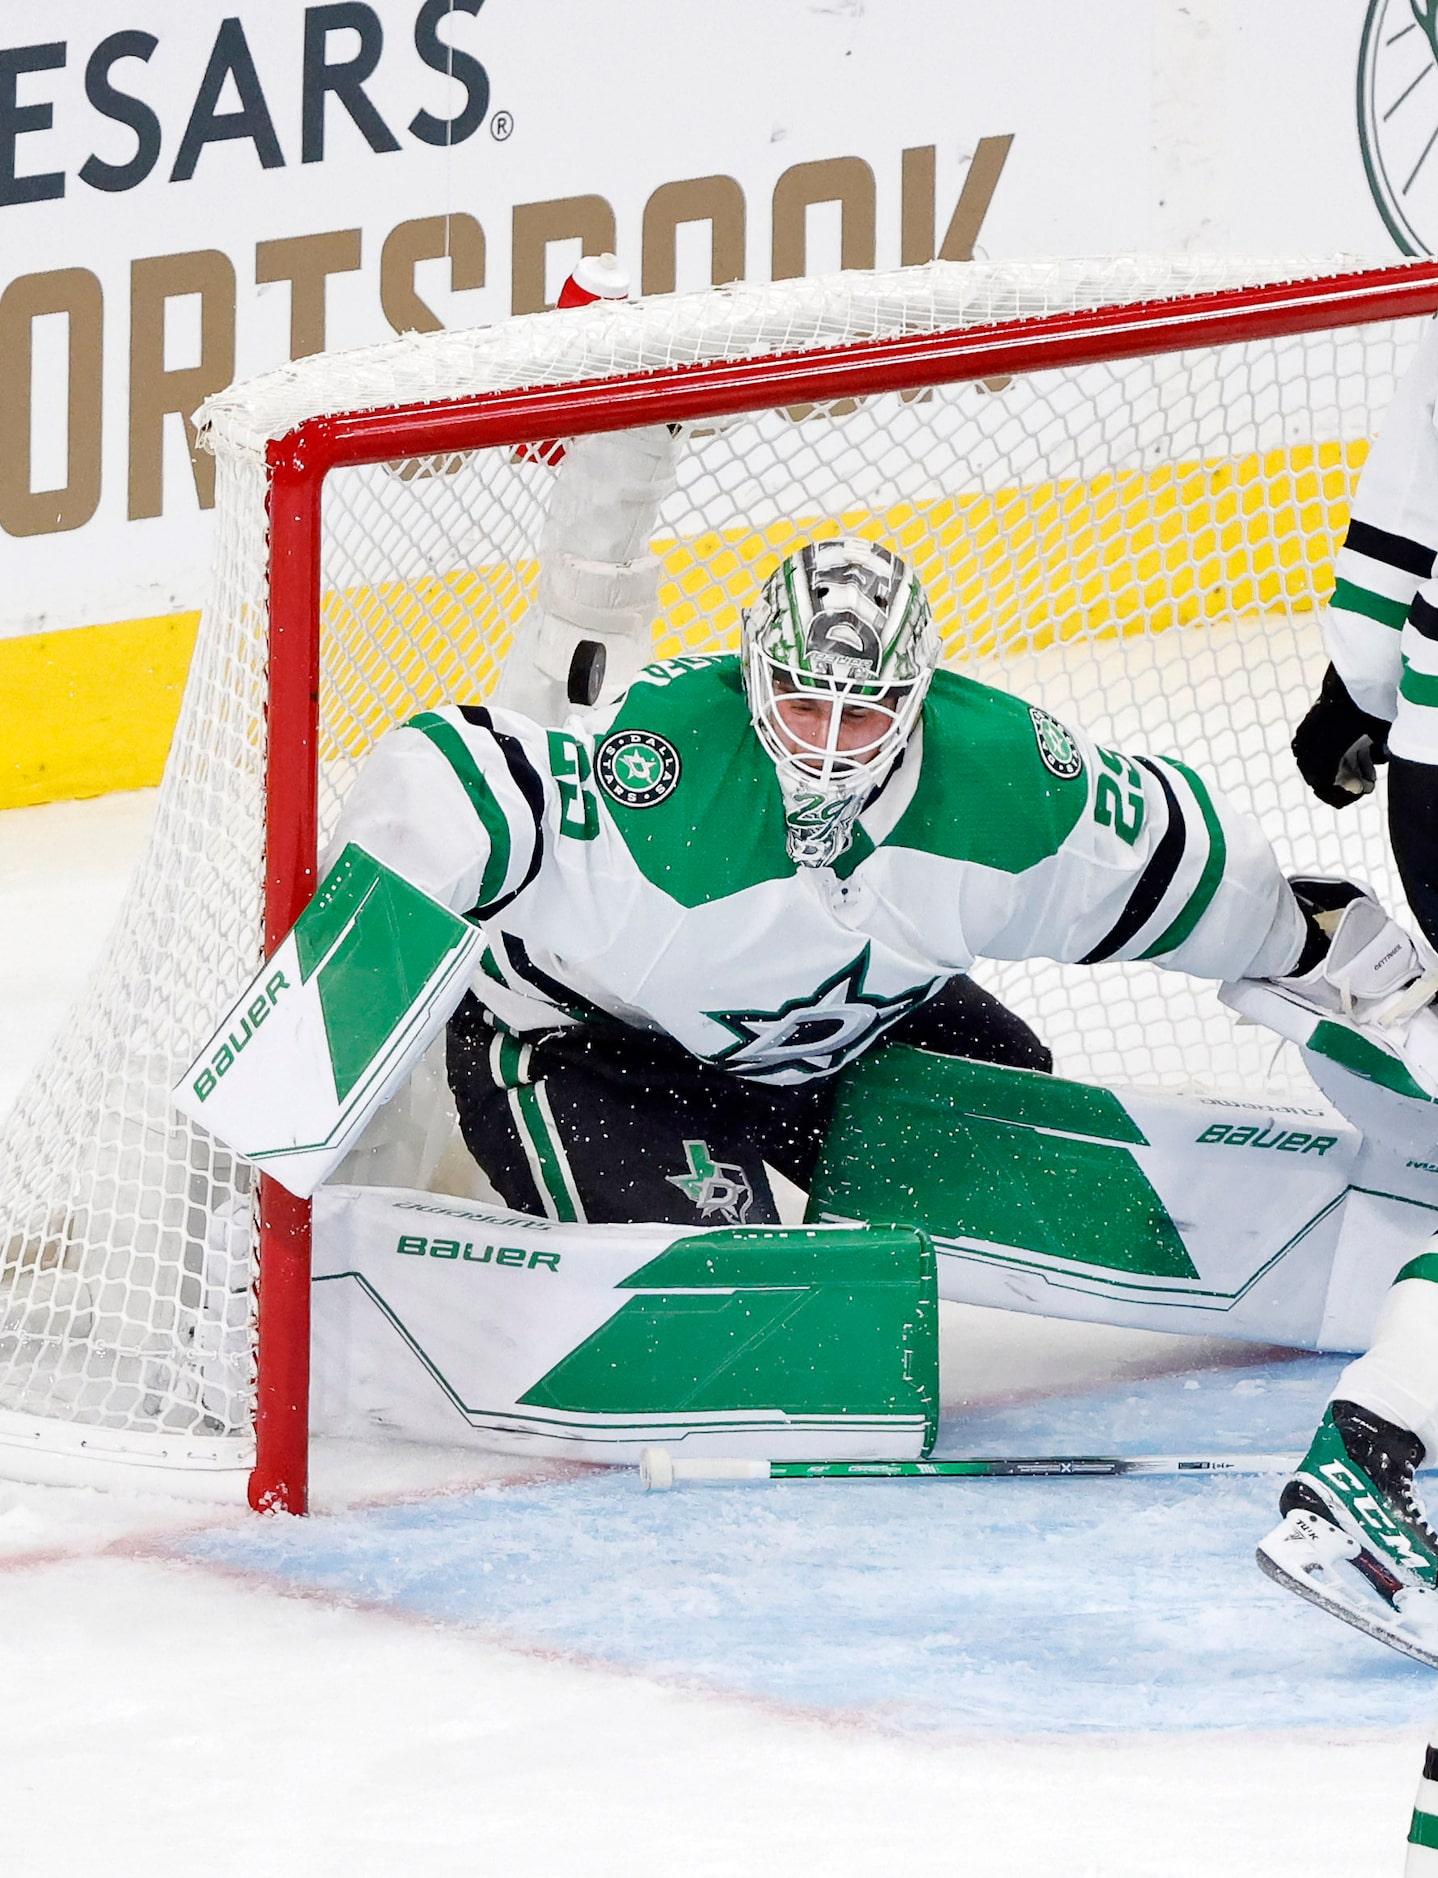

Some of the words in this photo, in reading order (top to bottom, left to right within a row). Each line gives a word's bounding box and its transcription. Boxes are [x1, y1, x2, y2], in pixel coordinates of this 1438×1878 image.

[629, 733, 677, 794] DALLAS
[787, 793, 855, 841] 29
[1319, 1458, 1431, 1568] CCM
